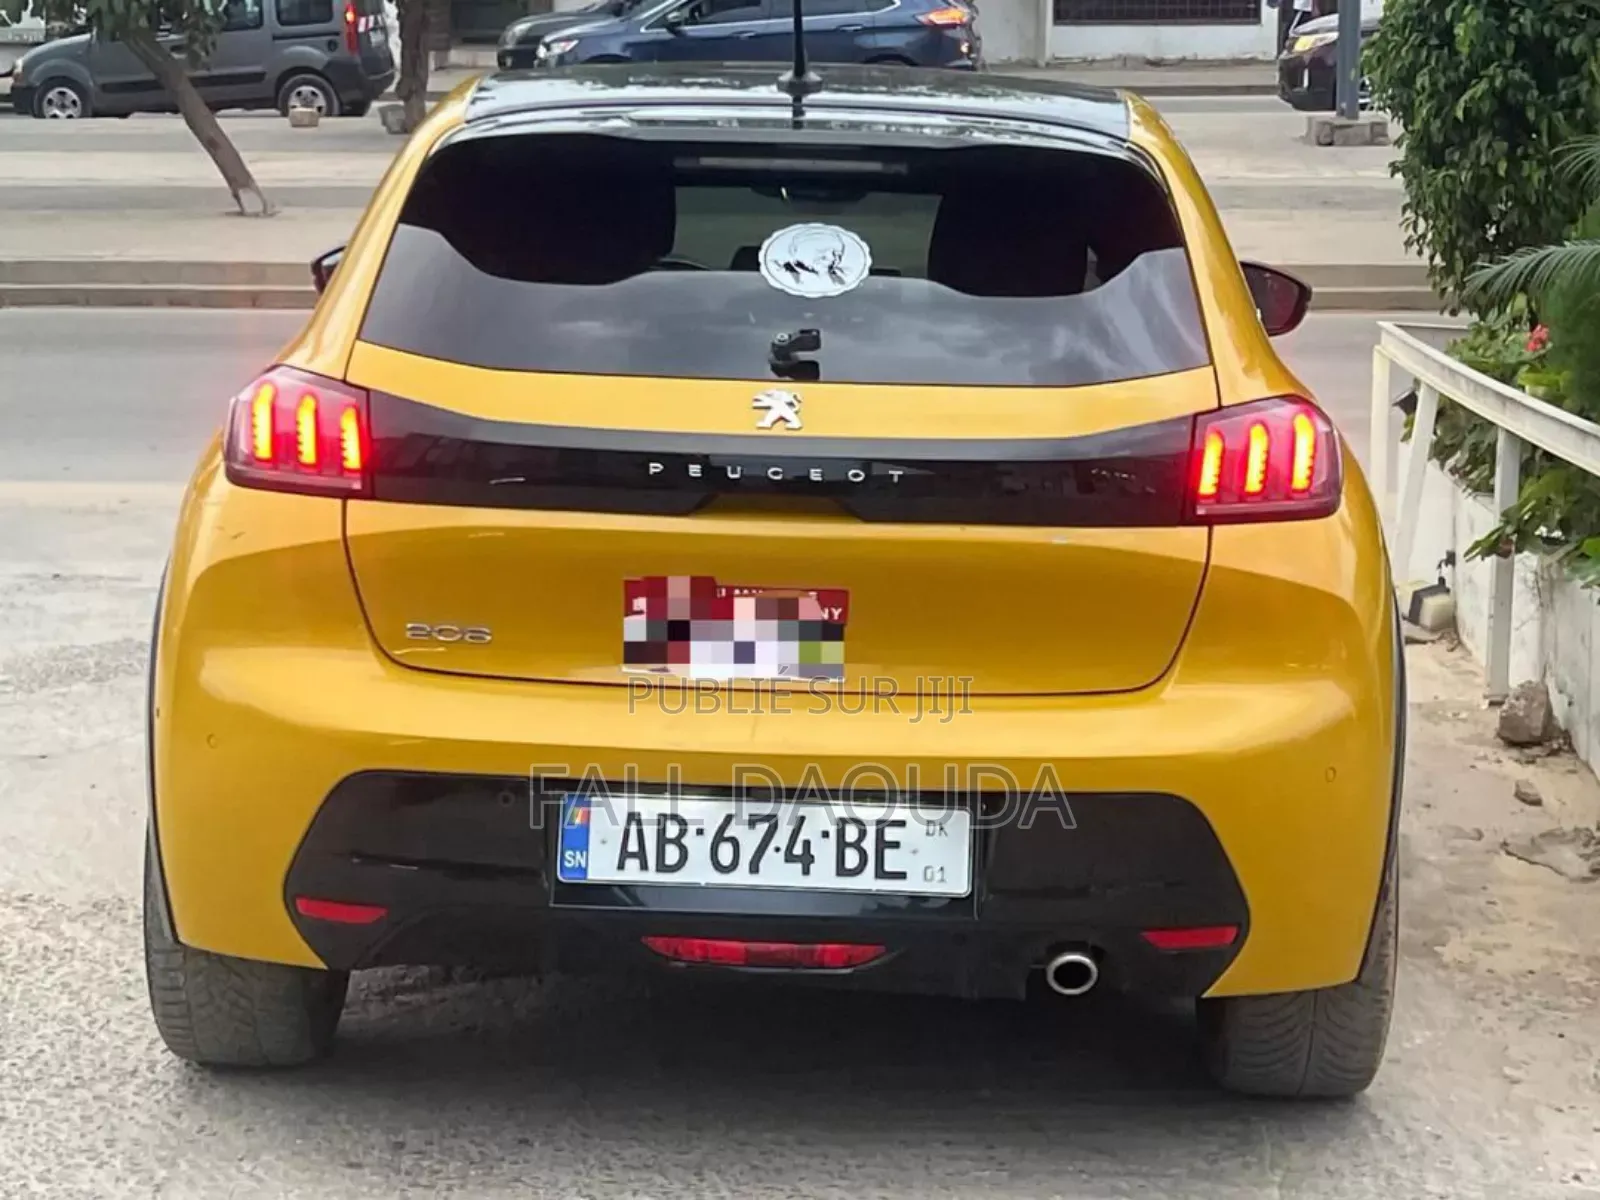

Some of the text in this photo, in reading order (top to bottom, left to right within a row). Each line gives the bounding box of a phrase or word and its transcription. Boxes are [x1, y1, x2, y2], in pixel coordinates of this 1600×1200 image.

[648, 462, 904, 483] PEUGEOT
[405, 622, 493, 644] 208
[563, 849, 587, 868] SN
[922, 864, 948, 884] 01
